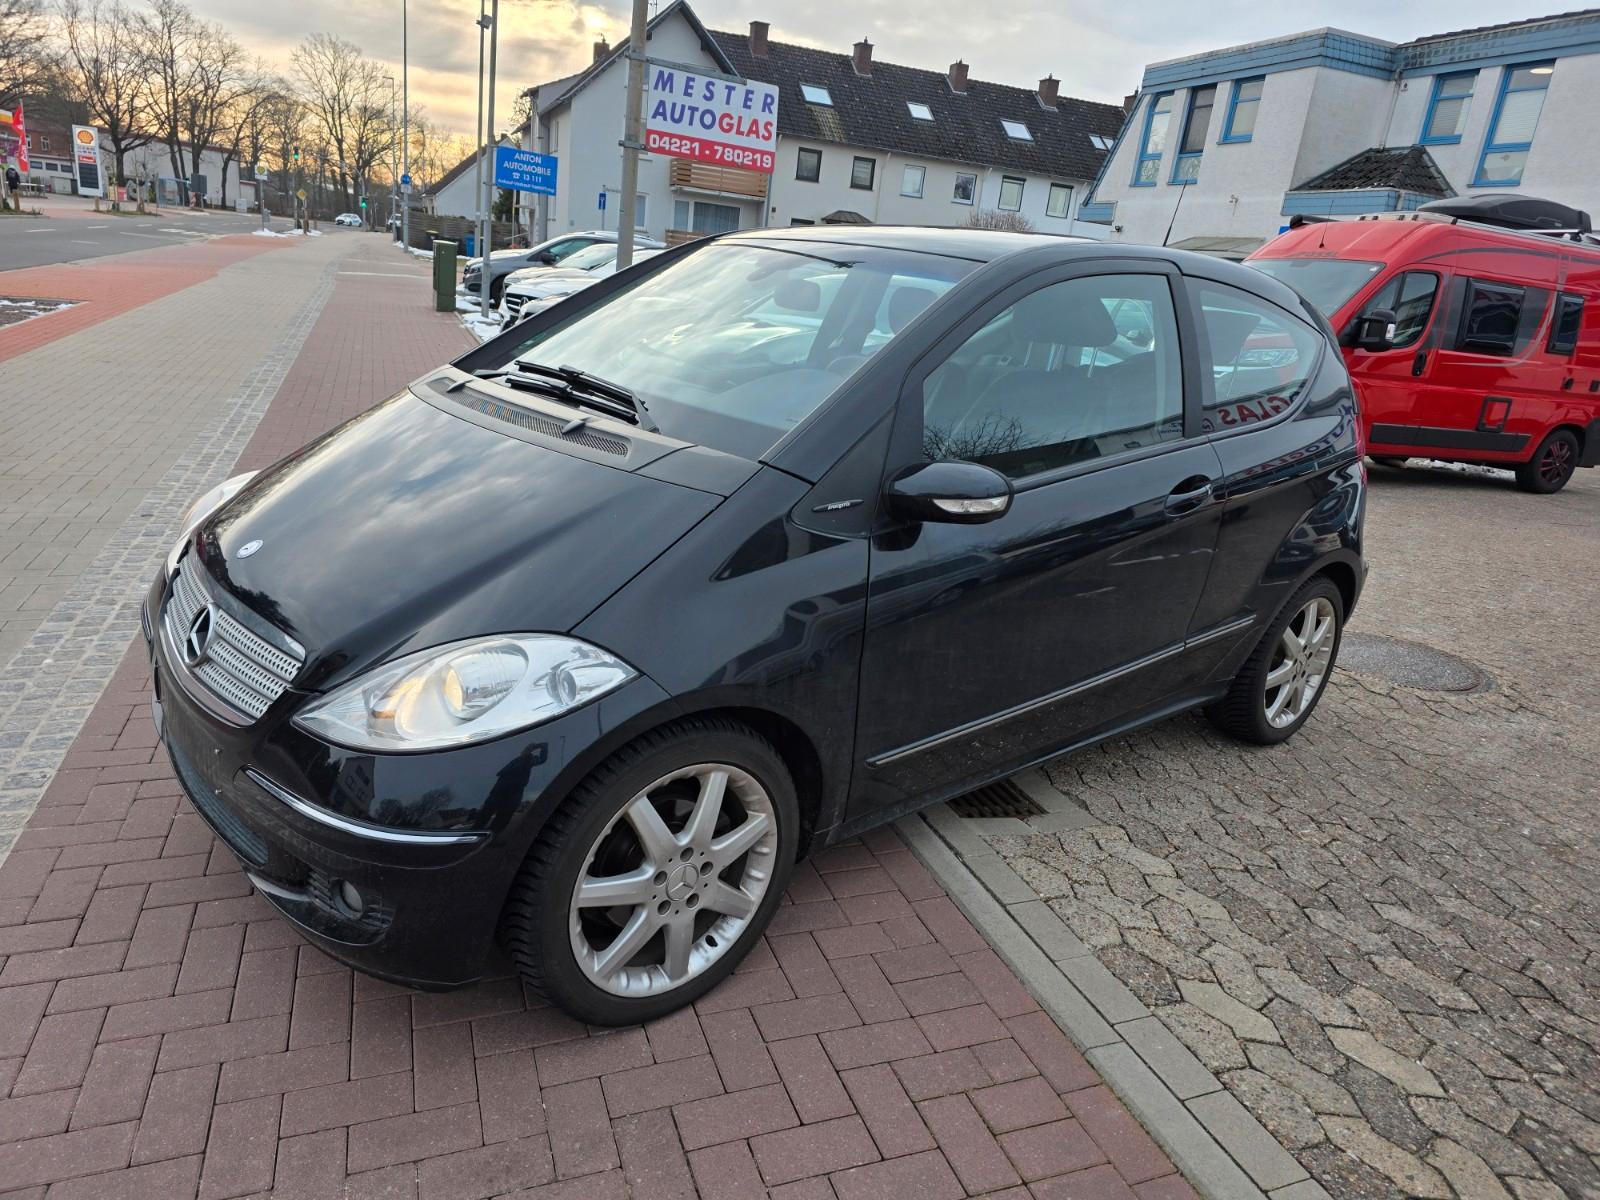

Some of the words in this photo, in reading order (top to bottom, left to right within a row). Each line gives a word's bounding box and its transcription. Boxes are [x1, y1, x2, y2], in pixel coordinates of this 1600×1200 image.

[653, 69, 775, 114] MESTER
[651, 99, 774, 142] AUTOGLAS
[503, 160, 552, 176] AUTOMOBILE
[514, 152, 542, 164] ANTON
[649, 134, 700, 156] 04221
[713, 145, 772, 168] 780219
